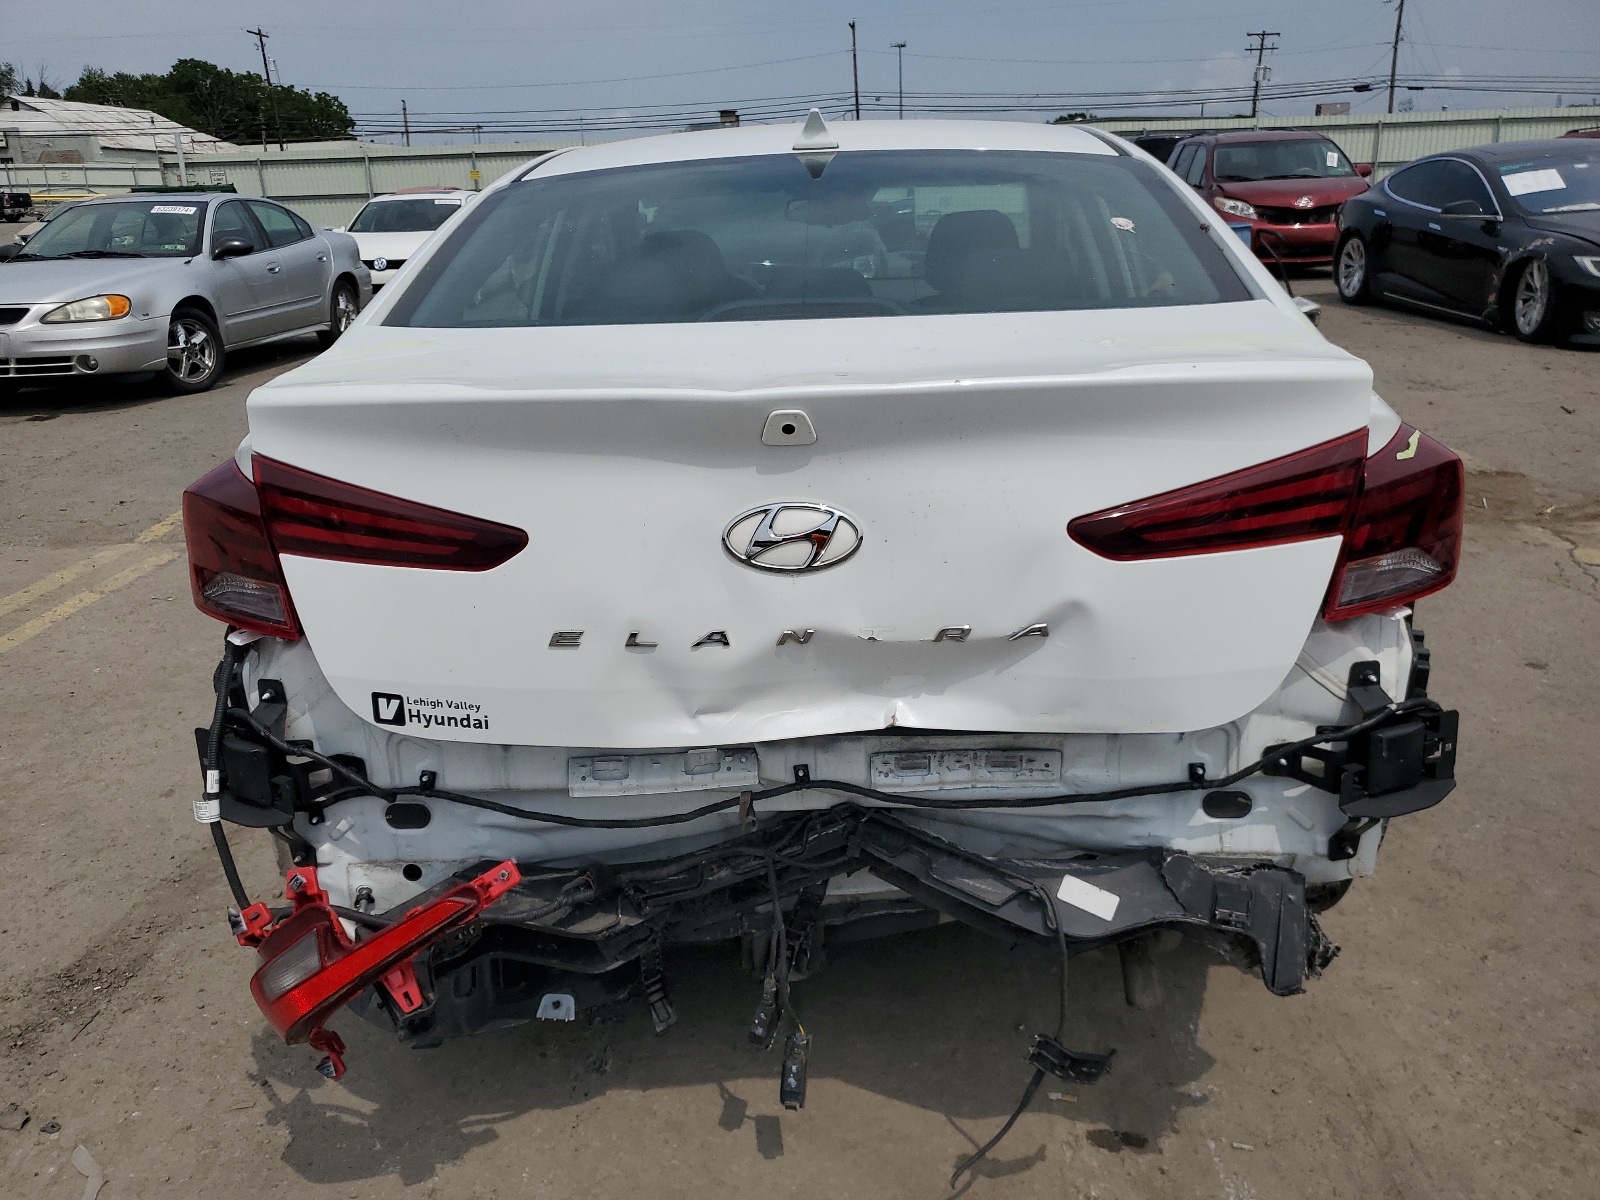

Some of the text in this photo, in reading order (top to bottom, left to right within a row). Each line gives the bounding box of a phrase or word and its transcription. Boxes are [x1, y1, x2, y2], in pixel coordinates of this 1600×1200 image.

[406, 696, 482, 713] Lehigh Valley
[408, 708, 490, 730] Hyundai
